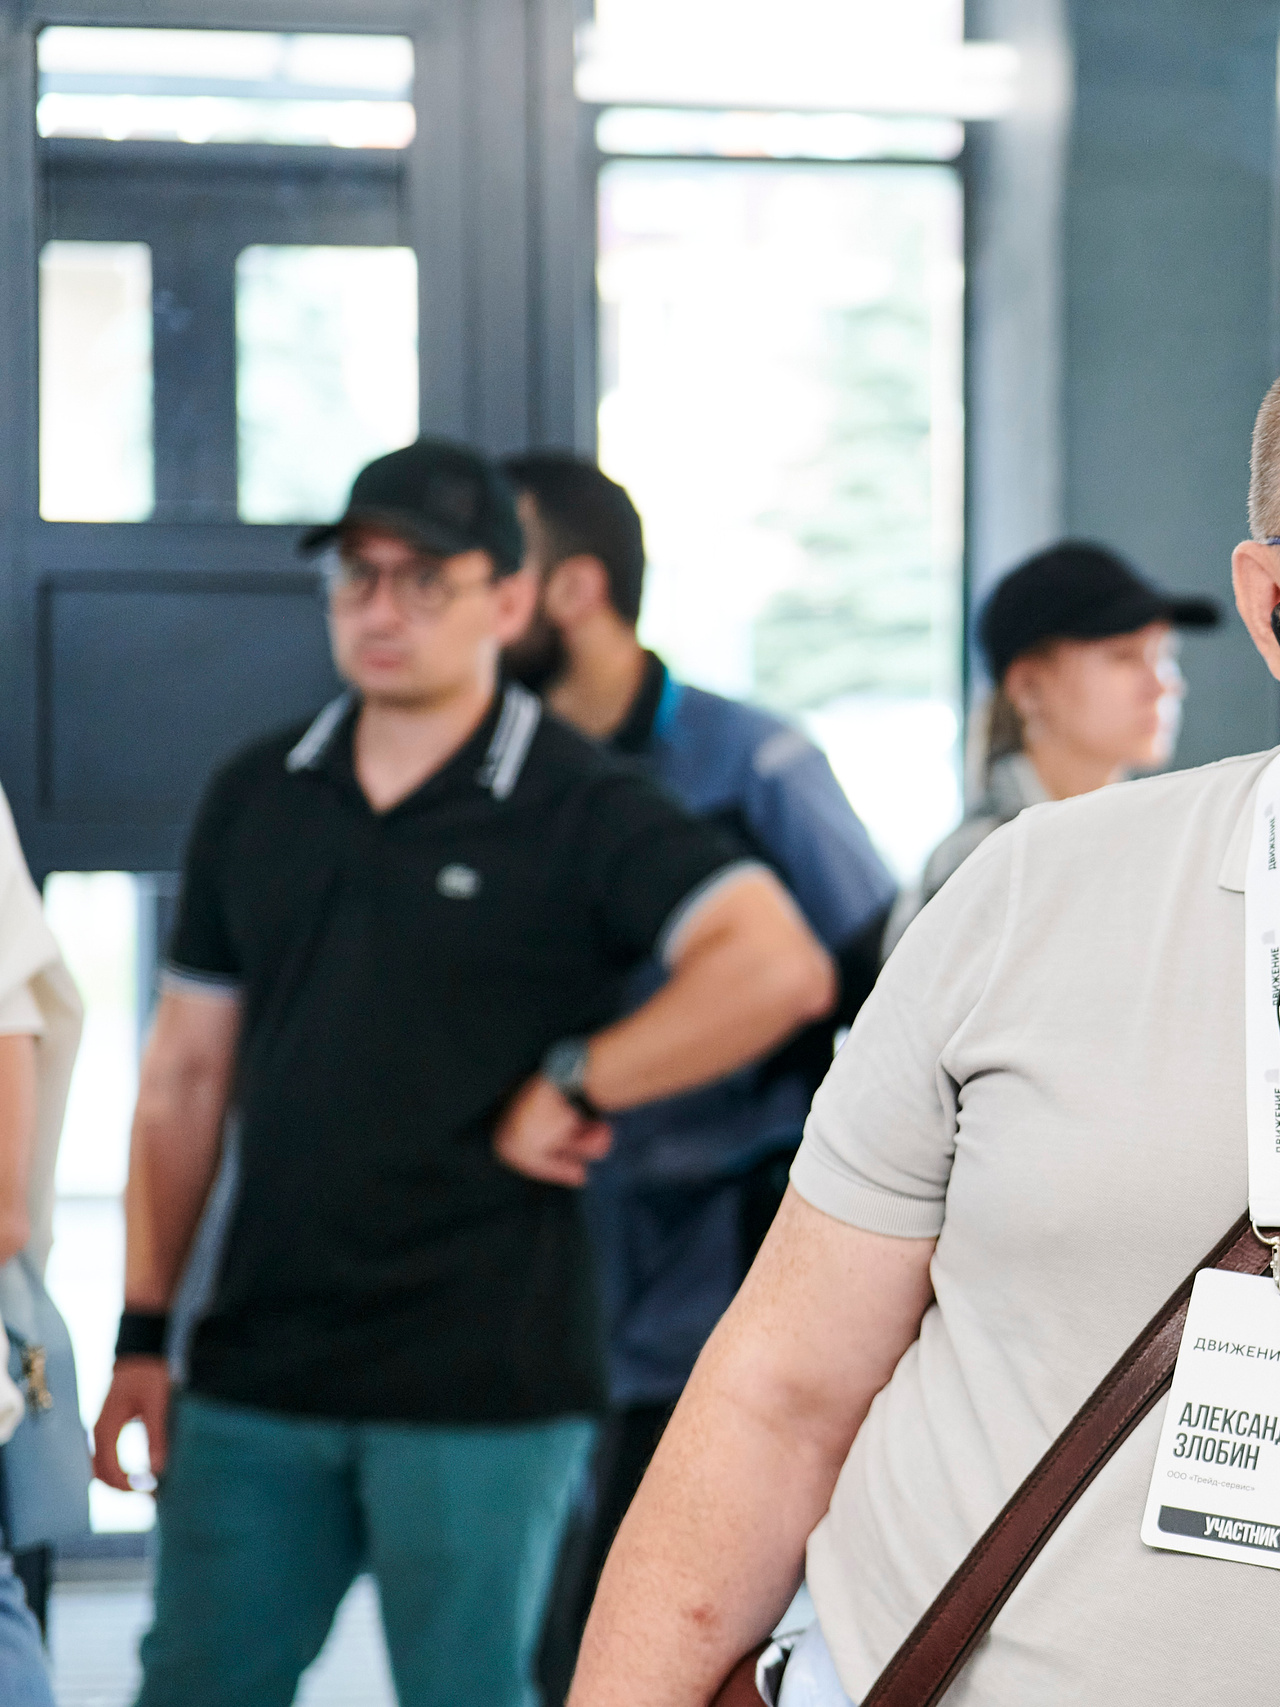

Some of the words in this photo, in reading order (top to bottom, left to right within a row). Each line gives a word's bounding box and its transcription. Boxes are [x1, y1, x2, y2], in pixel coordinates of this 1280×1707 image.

[1173, 1432, 1261, 1471] ЗЛОБИН
[1166, 1470, 1187, 1480] ООО
[1203, 1516, 1280, 1549] УЧАСТНИК
